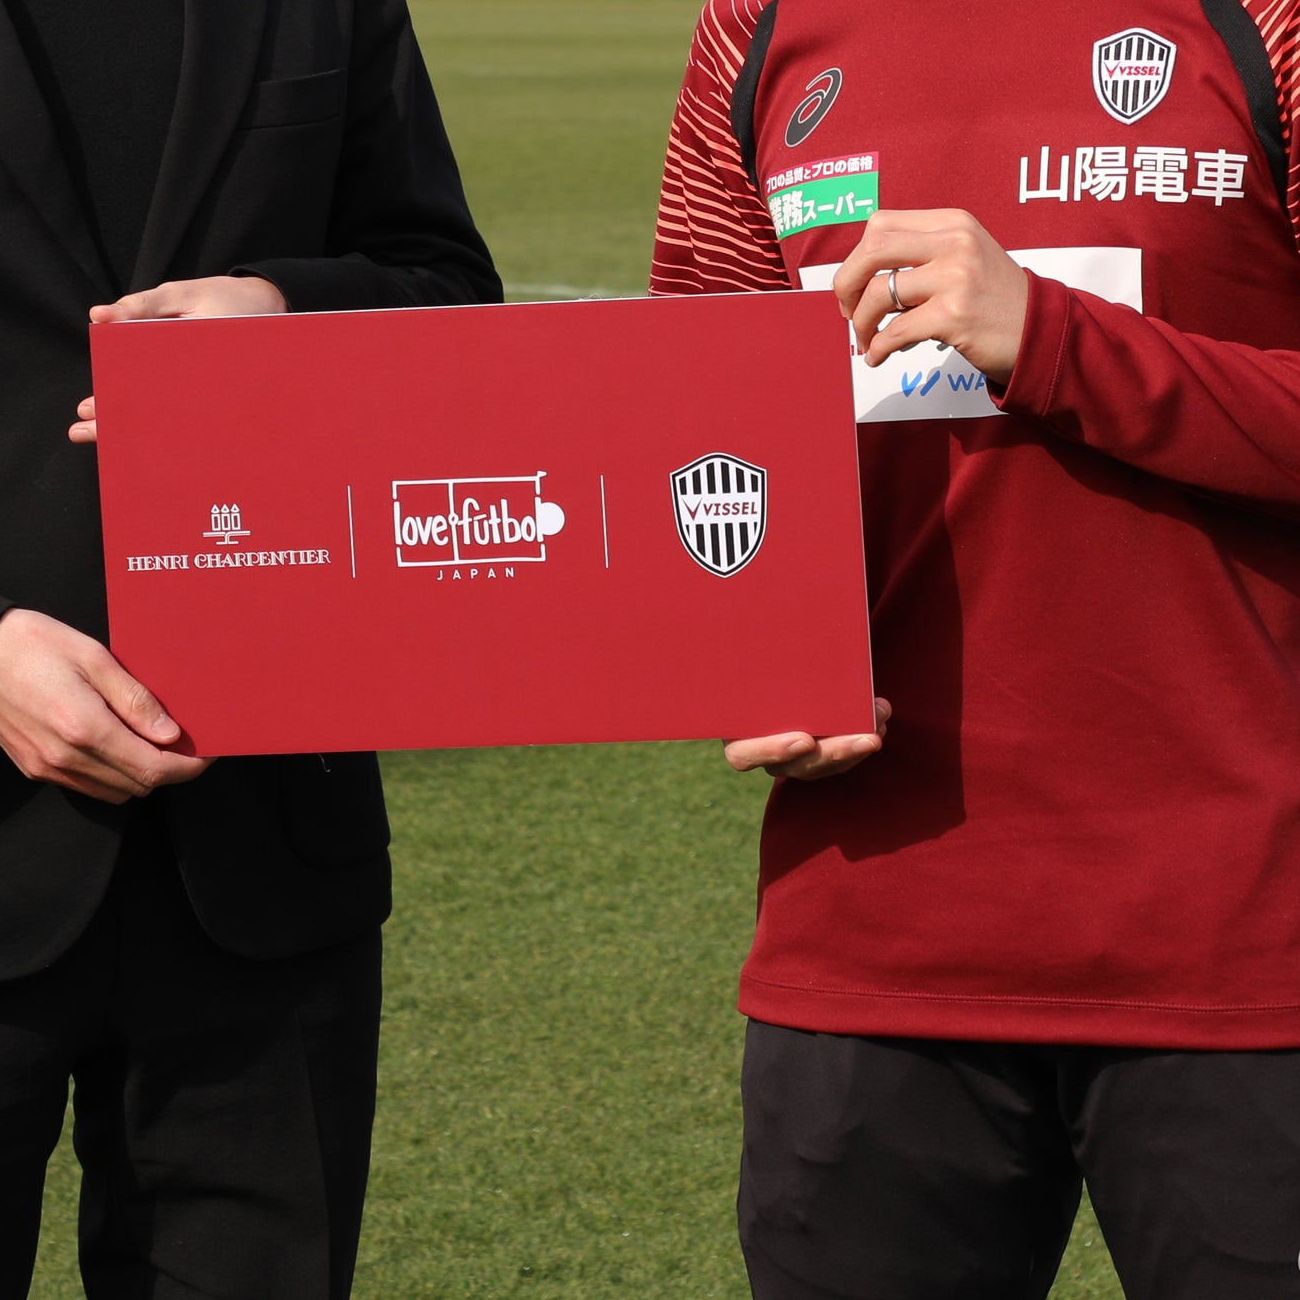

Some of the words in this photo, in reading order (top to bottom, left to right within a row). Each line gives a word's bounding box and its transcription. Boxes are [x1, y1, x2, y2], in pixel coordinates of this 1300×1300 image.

[1120, 66, 1161, 76] VISSEL
[1018, 145, 1249, 207] 山陽電車
[703, 501, 758, 517] VISSEL
[126, 554, 190, 572] HENRI
[193, 548, 332, 570] CHARPENTIER
[436, 566, 515, 581] JAPAN
